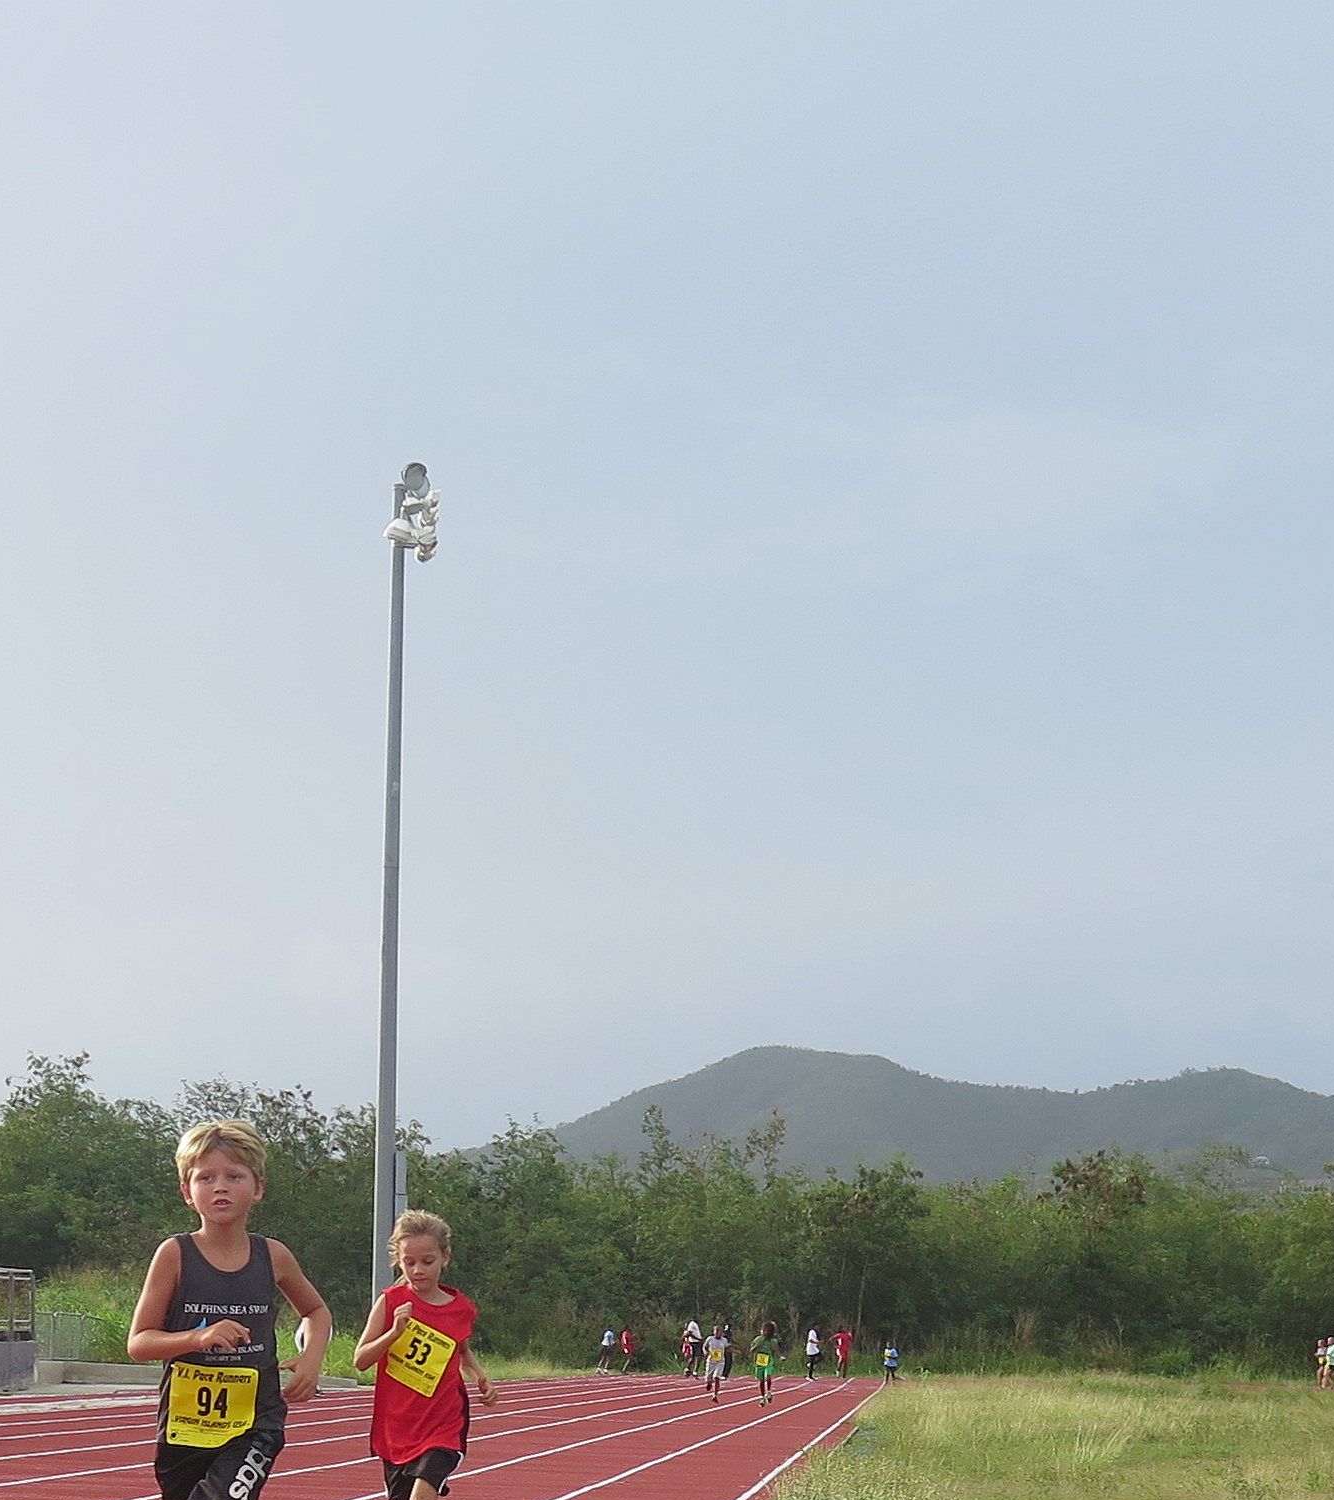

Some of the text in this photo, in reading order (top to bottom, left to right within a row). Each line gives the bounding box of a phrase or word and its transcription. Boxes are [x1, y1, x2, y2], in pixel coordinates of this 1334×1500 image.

[184, 1303, 269, 1315] DOLPHINS SEA SWIM
[237, 1343, 265, 1354] ISLANDS
[405, 1336, 432, 1366] 53
[177, 1366, 252, 1384] V.I. Pace Runners
[197, 1386, 228, 1419] 94
[201, 1420, 230, 1429] ISLANDS
